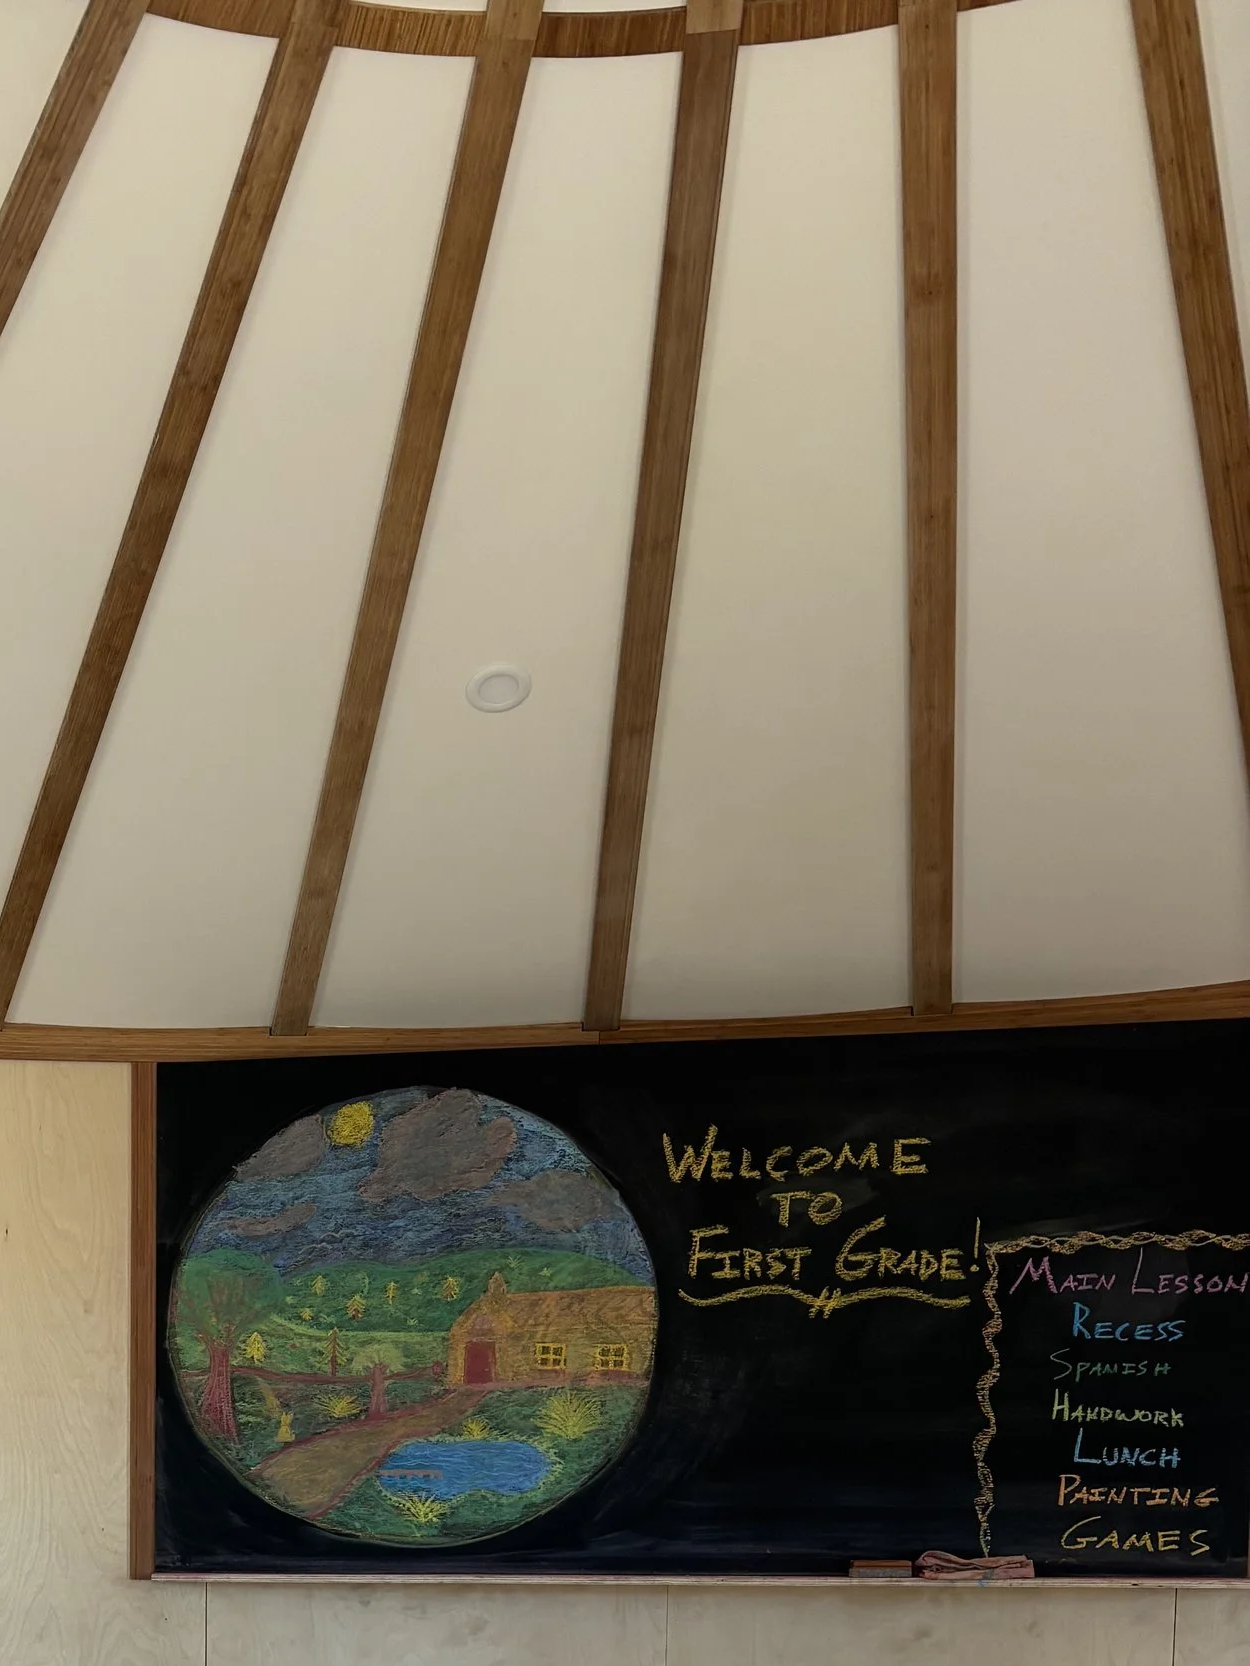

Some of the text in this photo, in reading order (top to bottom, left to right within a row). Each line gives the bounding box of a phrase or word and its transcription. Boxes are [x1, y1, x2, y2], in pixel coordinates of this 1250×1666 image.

[662, 1123, 932, 1183] WELCOME
[770, 1191, 843, 1227] TO
[687, 1216, 981, 1281] FIRST GRADE!
[1009, 1247, 1250, 1295] MAIN LESSON
[1072, 1301, 1186, 1342] RECESS
[1050, 1348, 1171, 1382] SPANISH
[1052, 1388, 1184, 1428] HANDWORK
[1073, 1427, 1181, 1469] LUNCH
[1057, 1474, 1219, 1507] PAINTING
[1061, 1515, 1210, 1557] GAMES
